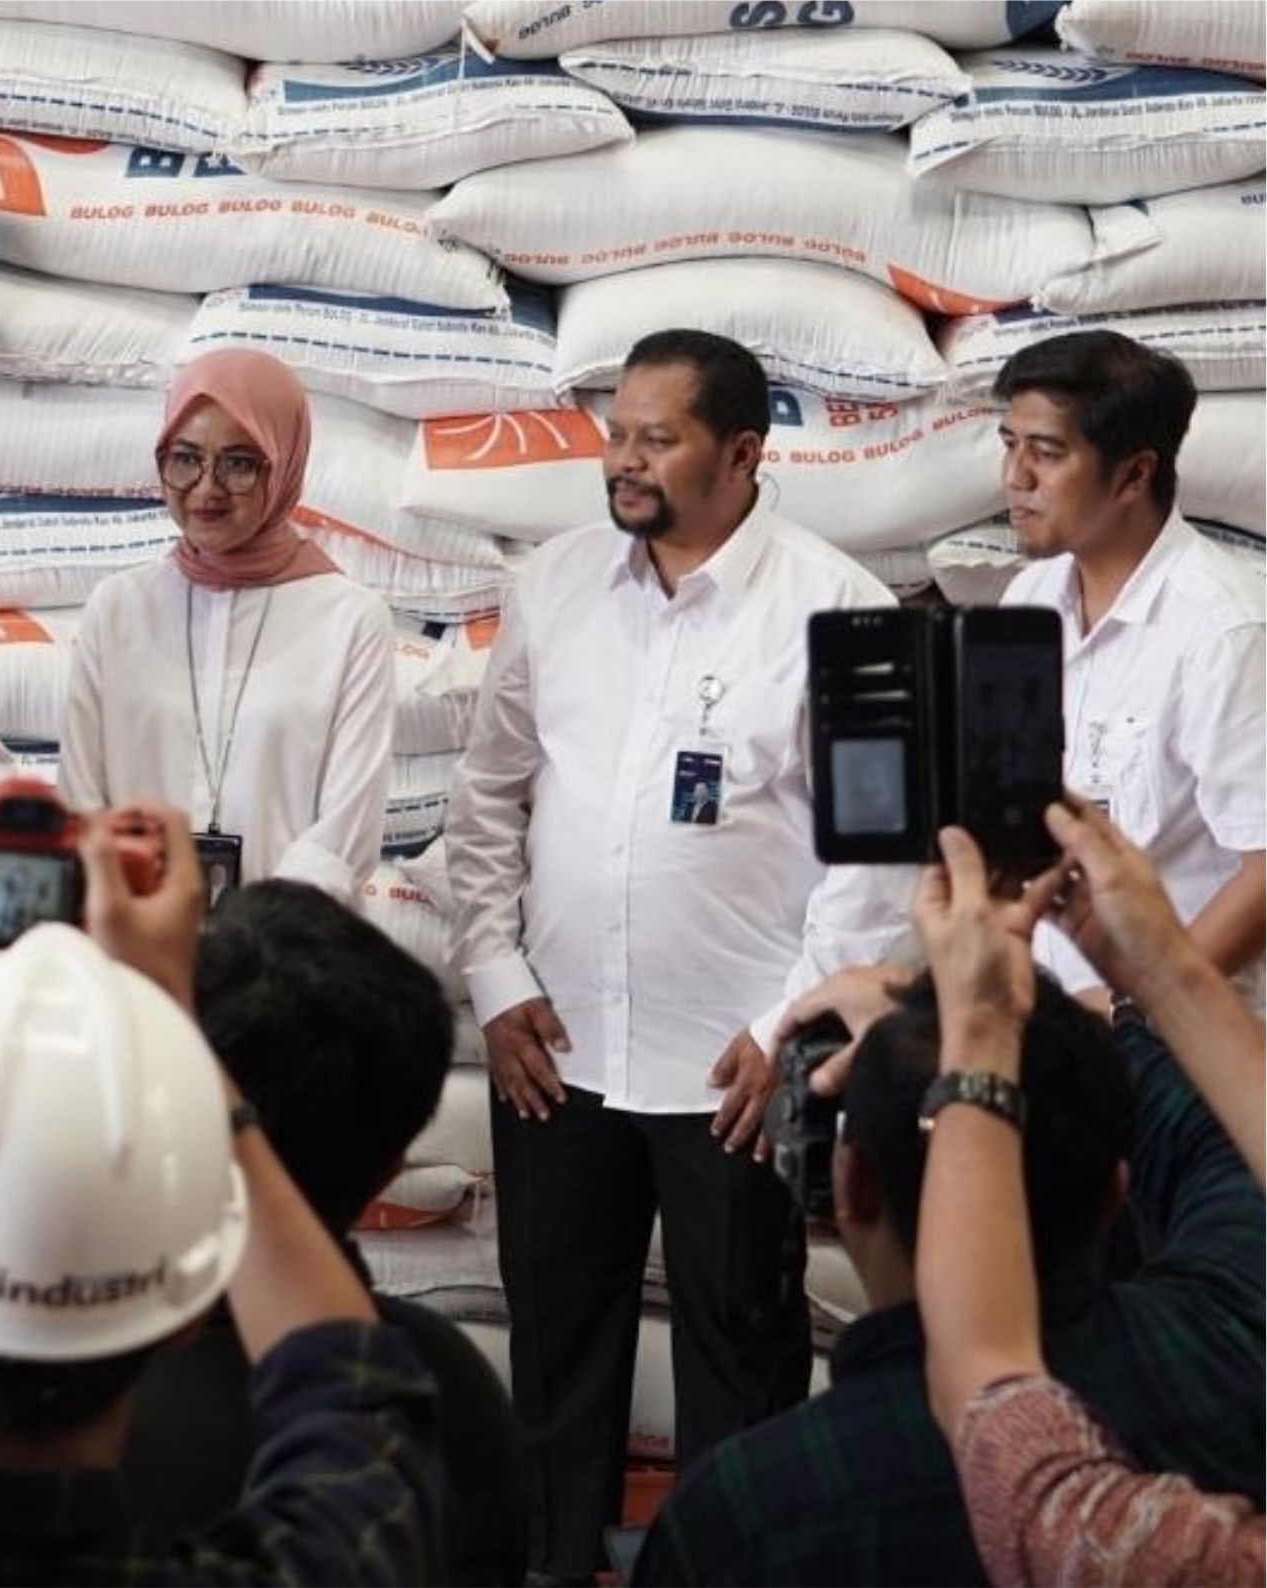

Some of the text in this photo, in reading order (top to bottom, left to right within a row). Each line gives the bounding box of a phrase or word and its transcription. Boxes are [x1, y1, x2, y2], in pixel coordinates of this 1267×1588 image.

[70, 206, 134, 219] BULOG
[145, 202, 209, 217] BULOG
[218, 200, 282, 213] BULOG
[291, 201, 356, 220] BULOG
[790, 451, 855, 463] BULOG
[863, 429, 925, 460] BULOG
